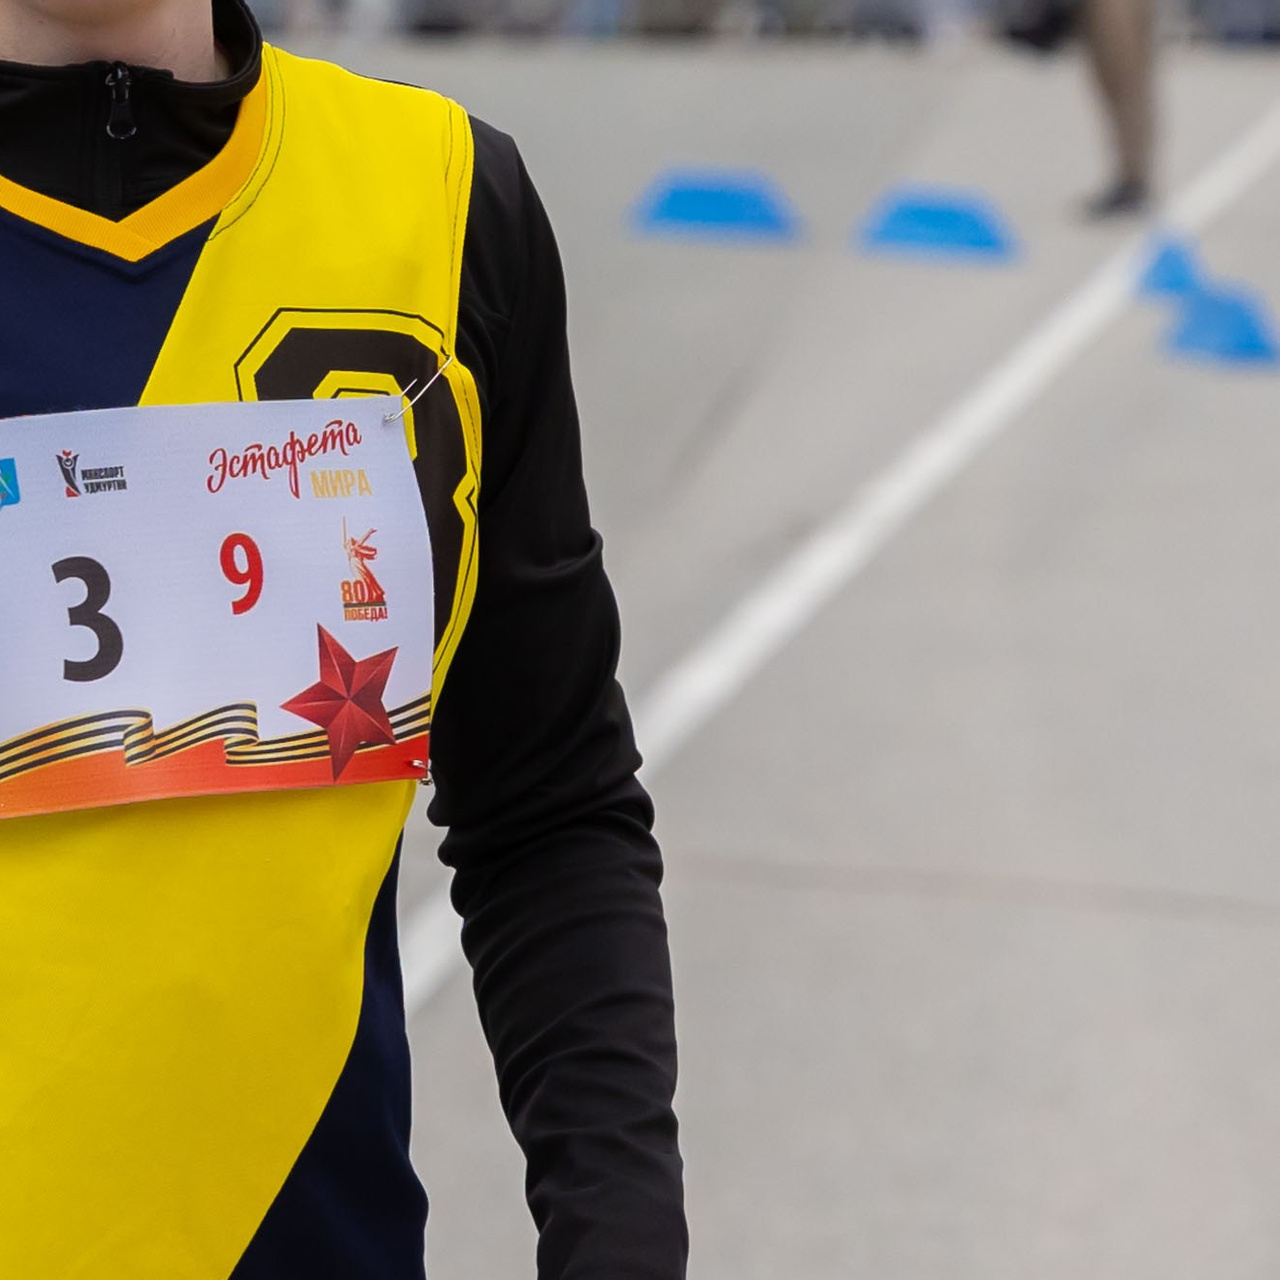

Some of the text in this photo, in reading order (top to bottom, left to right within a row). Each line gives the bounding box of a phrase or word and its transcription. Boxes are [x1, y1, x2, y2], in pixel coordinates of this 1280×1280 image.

[206, 419, 363, 500] Эстафета
[309, 469, 374, 499] МИРА
[219, 532, 264, 616] 9
[340, 579, 367, 604] 80
[51, 556, 124, 683] 3
[343, 606, 389, 623] ПОБЕДА!
